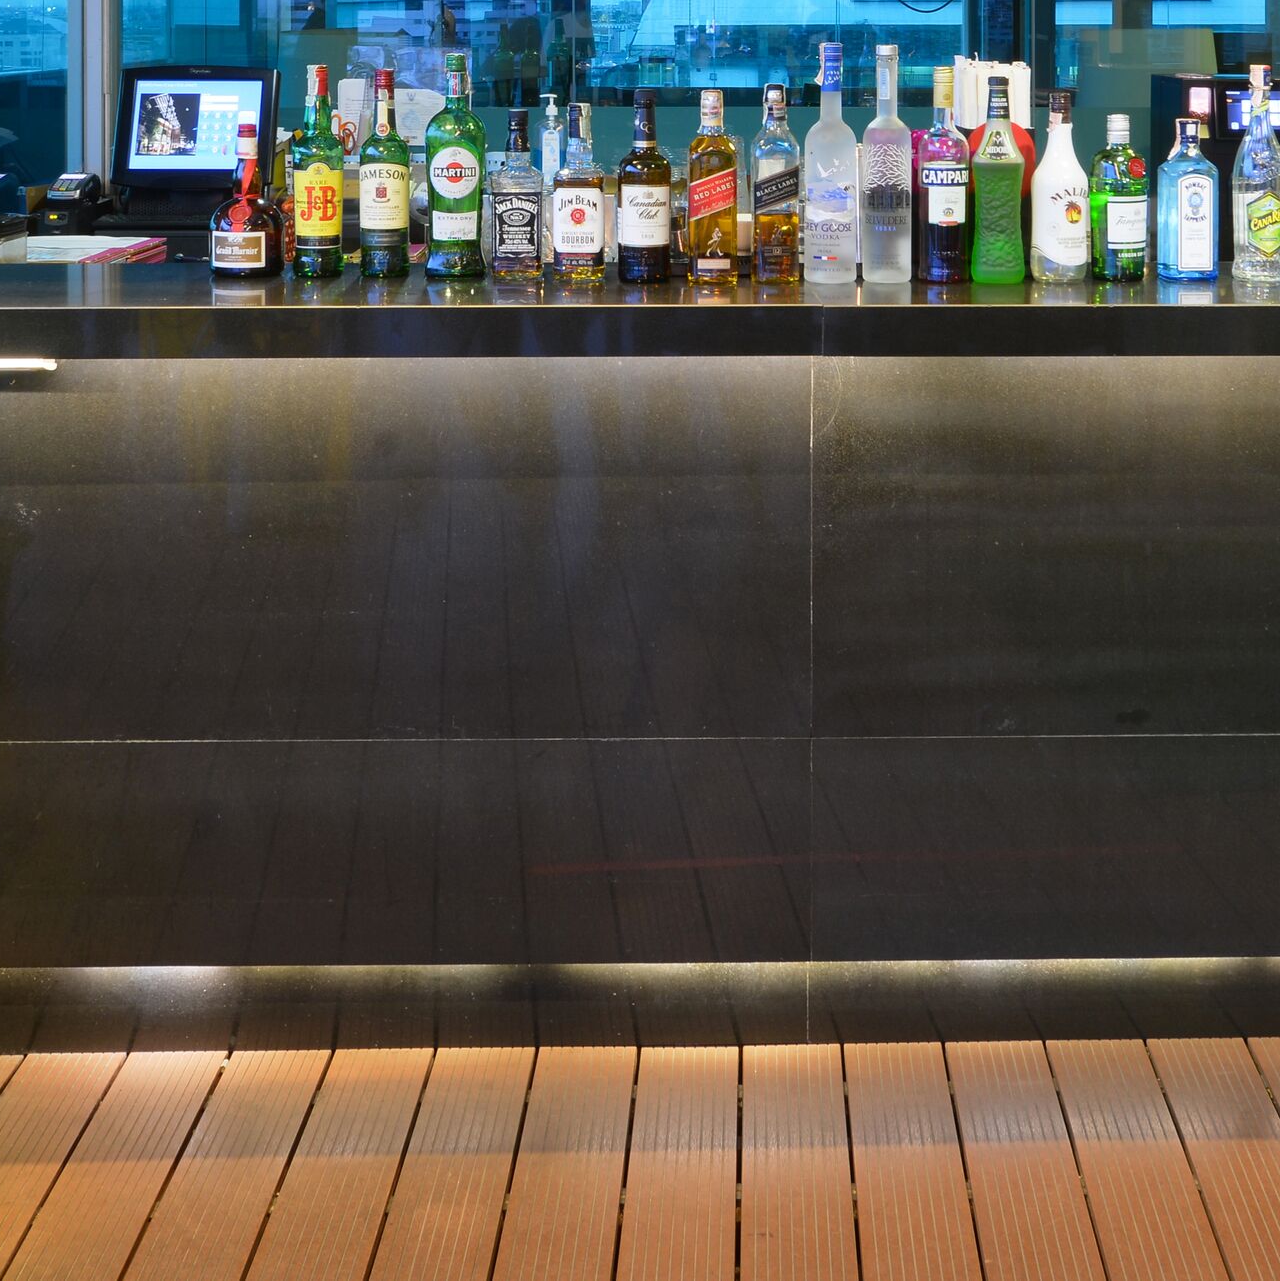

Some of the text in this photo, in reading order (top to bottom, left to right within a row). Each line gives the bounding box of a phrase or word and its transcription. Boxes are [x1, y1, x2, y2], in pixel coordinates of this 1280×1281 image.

[360, 168, 406, 182] JAMESON
[434, 167, 476, 177] MARTINI
[922, 169, 969, 184] CAMPARI
[693, 182, 735, 201] RED LABEL
[756, 177, 798, 197] BLACK LABEL
[300, 185, 338, 222] J&B
[495, 200, 512, 214] JACK
[558, 194, 598, 212] JIM BEAM
[627, 195, 667, 208] Canadian
[636, 207, 658, 220] Club
[821, 222, 852, 233] GOOSE
[561, 235, 595, 244] BOURBON
